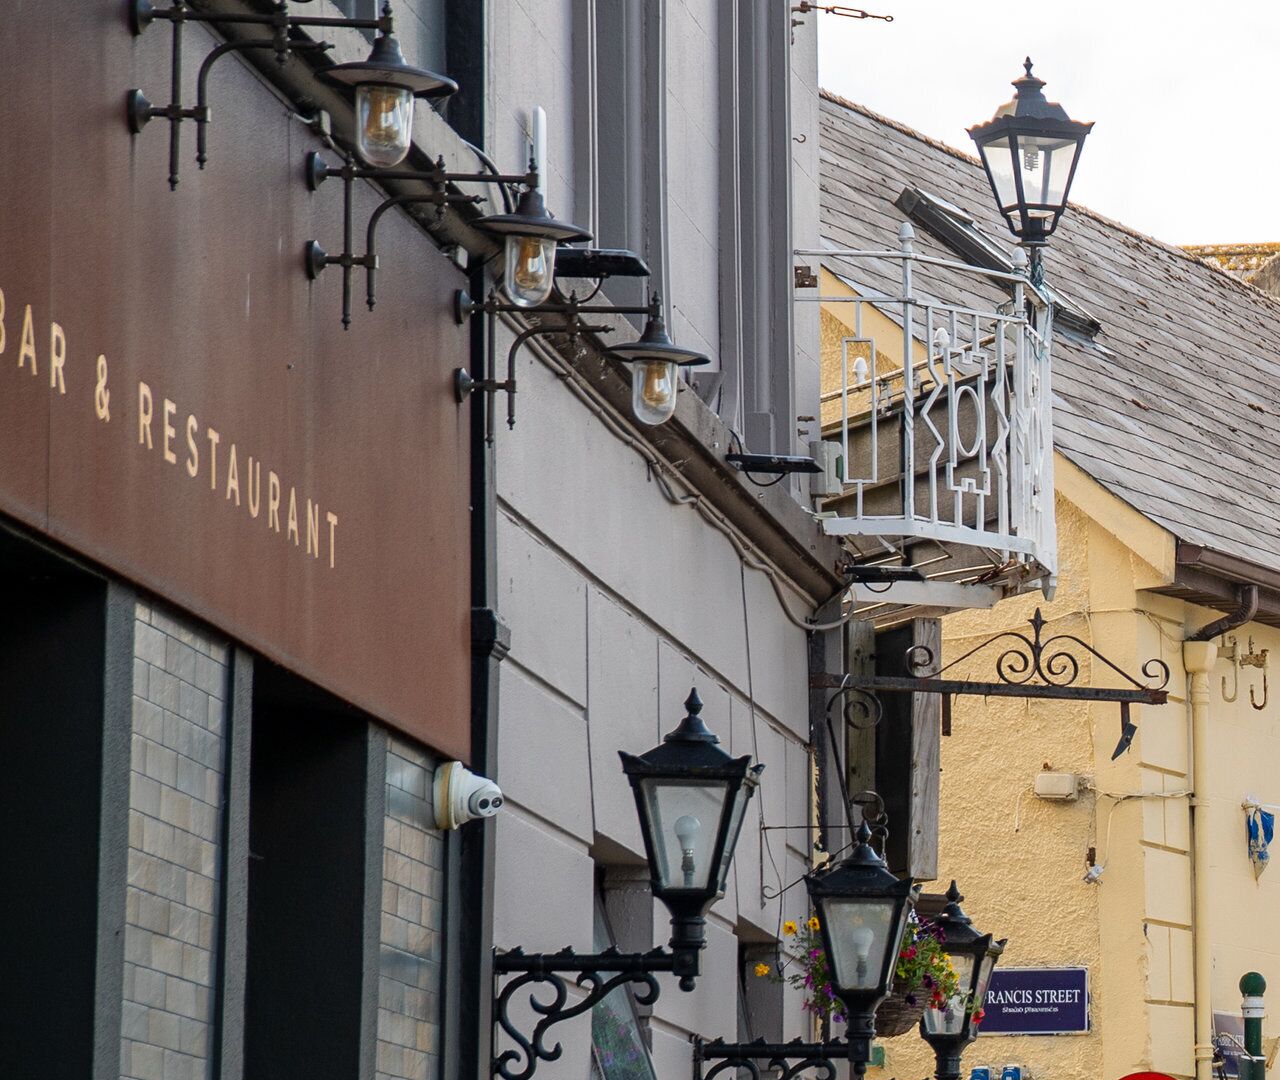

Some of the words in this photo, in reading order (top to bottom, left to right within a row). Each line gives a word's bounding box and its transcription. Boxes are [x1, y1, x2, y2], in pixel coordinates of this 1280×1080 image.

[95, 354, 110, 422] &
[138, 381, 338, 568] RESTAURANT
[986, 990, 1032, 1004] RANCIS
[1035, 989, 1080, 1003] STREET
